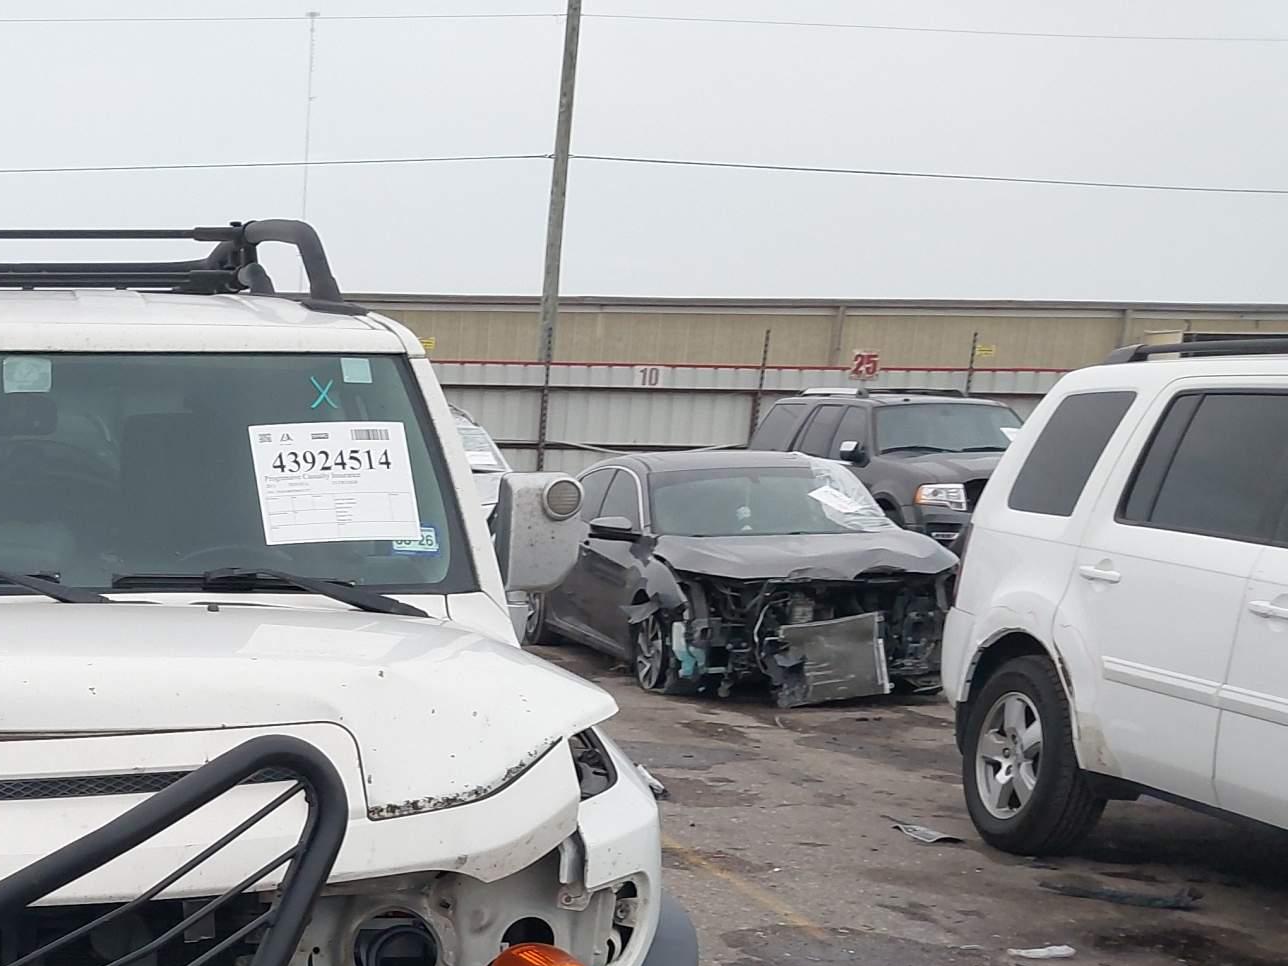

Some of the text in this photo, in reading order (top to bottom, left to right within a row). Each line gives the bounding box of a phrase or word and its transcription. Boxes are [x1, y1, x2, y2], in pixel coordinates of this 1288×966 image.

[853, 354, 878, 375] 25
[640, 367, 659, 386] 10
[272, 448, 392, 473] 43924514
